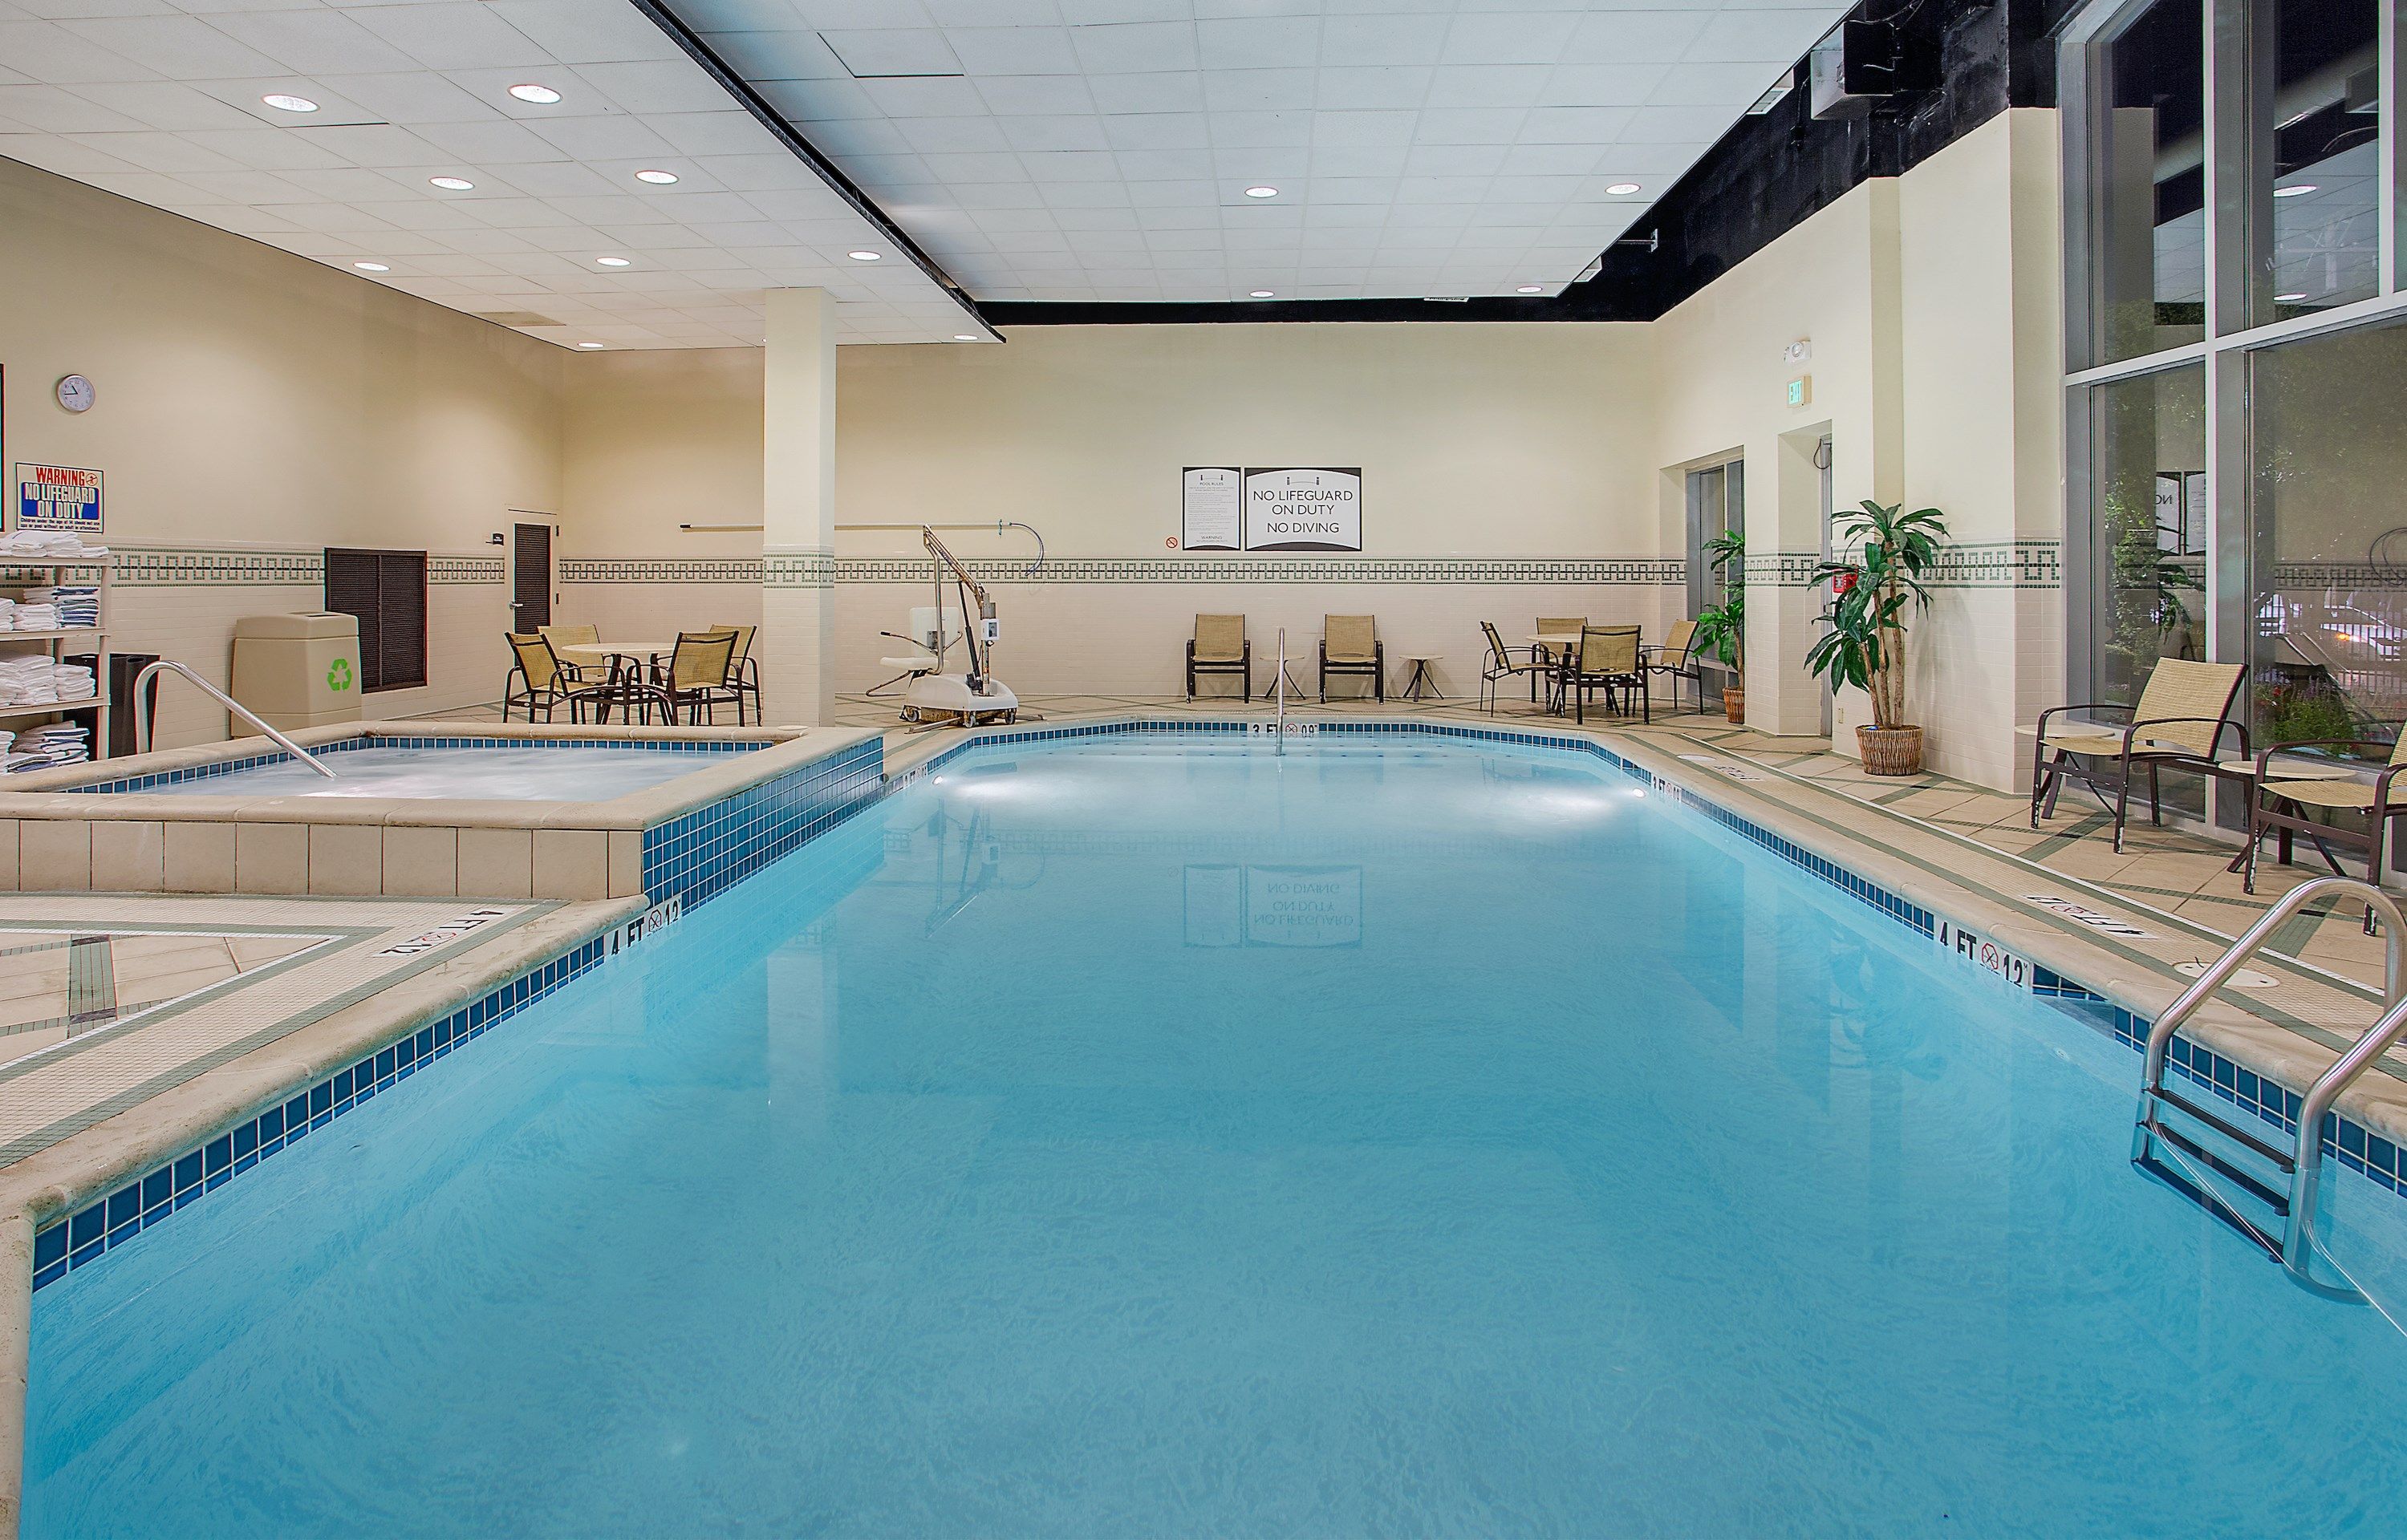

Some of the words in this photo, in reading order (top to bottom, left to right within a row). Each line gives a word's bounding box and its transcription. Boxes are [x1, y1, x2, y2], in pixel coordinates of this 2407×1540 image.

[36, 467, 85, 486] WARNING
[25, 483, 39, 500] NO
[41, 484, 95, 504] LIFEGUARD
[1253, 490, 1274, 500] NO
[1279, 490, 1354, 500] LIFEGUARD
[38, 500, 53, 517] ON
[56, 501, 84, 519] DUTY
[1272, 505, 1293, 514] ON
[1297, 505, 1334, 514] DUTY
[1268, 523, 1288, 533] NO
[1293, 523, 1339, 533] DIVING
[611, 930, 620, 955] 4
[627, 916, 645, 948] FT
[1940, 921, 1949, 946] 4
[1957, 928, 1977, 960] FT
